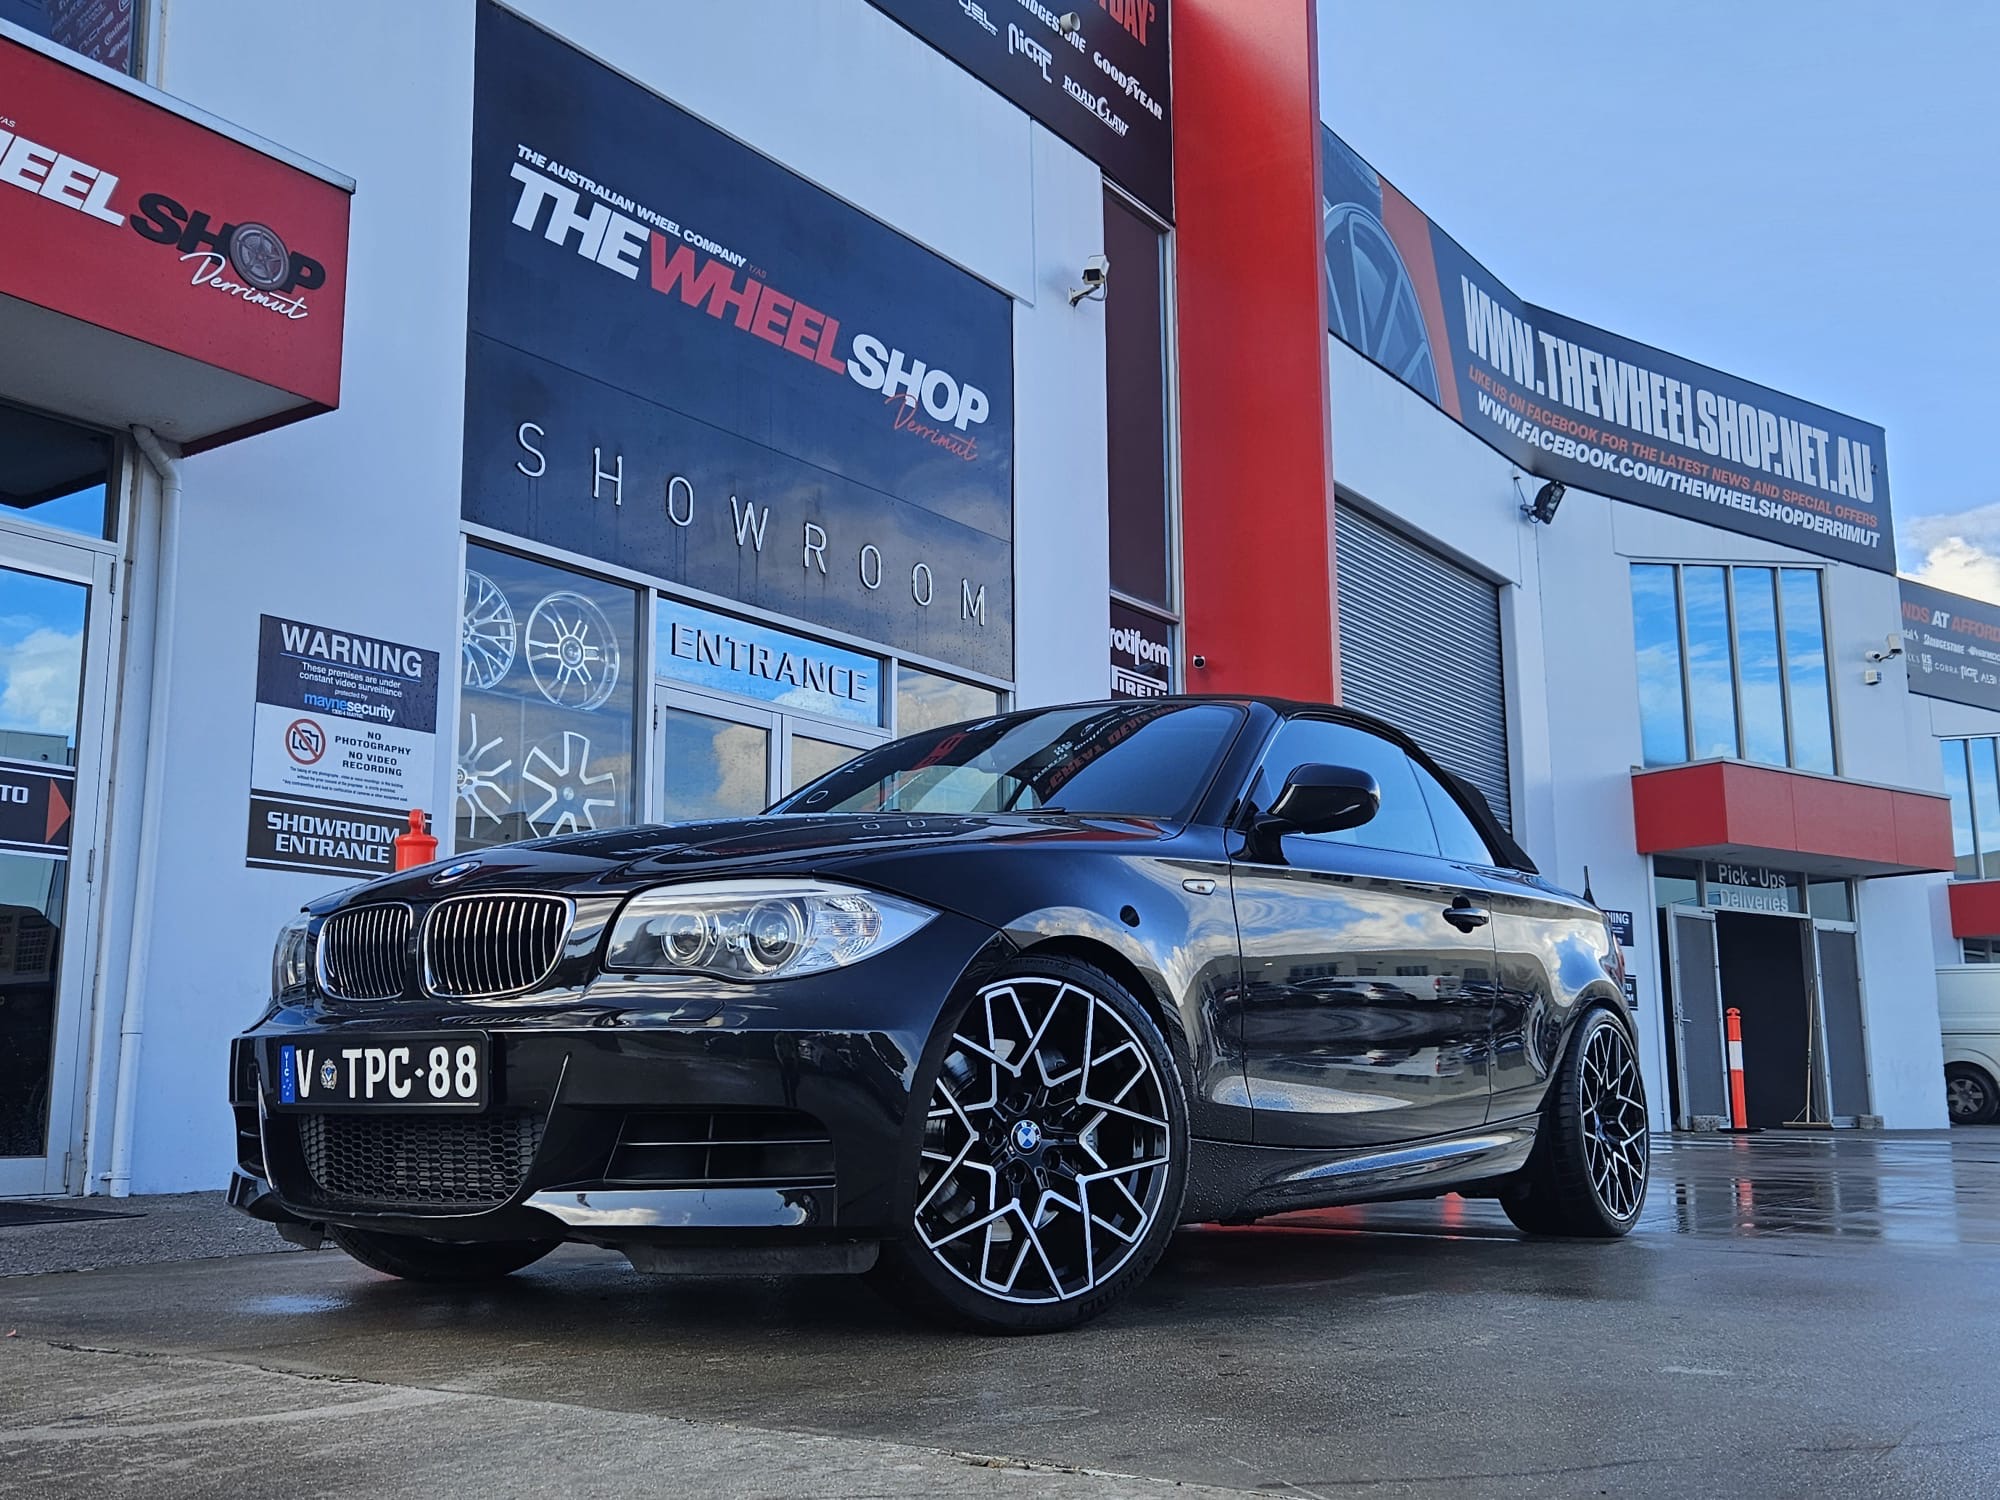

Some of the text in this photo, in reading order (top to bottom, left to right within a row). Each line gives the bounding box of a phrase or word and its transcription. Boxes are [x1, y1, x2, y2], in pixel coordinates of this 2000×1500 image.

[1093, 51, 1163, 120] GOODYEAR
[518, 143, 547, 168] THE
[546, 161, 635, 213] AUSTRALIAN
[636, 204, 682, 237] WHEEL
[683, 229, 747, 267] COMPANY
[180, 251, 308, 319] Derrimut
[884, 393, 978, 461] Derrimut
[1469, 364, 1878, 528] LIKE US ON FACEBOOK FOR THE LATEST NEWS AND SPECIAL OFFERS
[1478, 391, 1880, 549] WWW.FACEBOOK.COM/THEWHEELSHOPDERRIMUT
[1931, 610, 1950, 629] AT
[281, 623, 422, 678] WARNING
[671, 622, 868, 703] ENTRANCE
[1109, 628, 1171, 667] rotiform
[299, 671, 403, 698] constant video surveillance
[302, 661, 401, 689] These premises are under
[1111, 664, 1168, 697] PIREL
[335, 735, 412, 755] PHOTOGRAPHY
[367, 731, 381, 740] NO
[342, 760, 402, 776] RECORDING
[348, 750, 397, 766] NO VIDEO
[0, 784, 29, 804] TO
[267, 811, 400, 844] SHOWROOM
[275, 833, 390, 864] ENTRANCE
[1718, 863, 1749, 886] Pick
[1759, 867, 1787, 891] Ups
[1720, 889, 1789, 913] Deliveries
